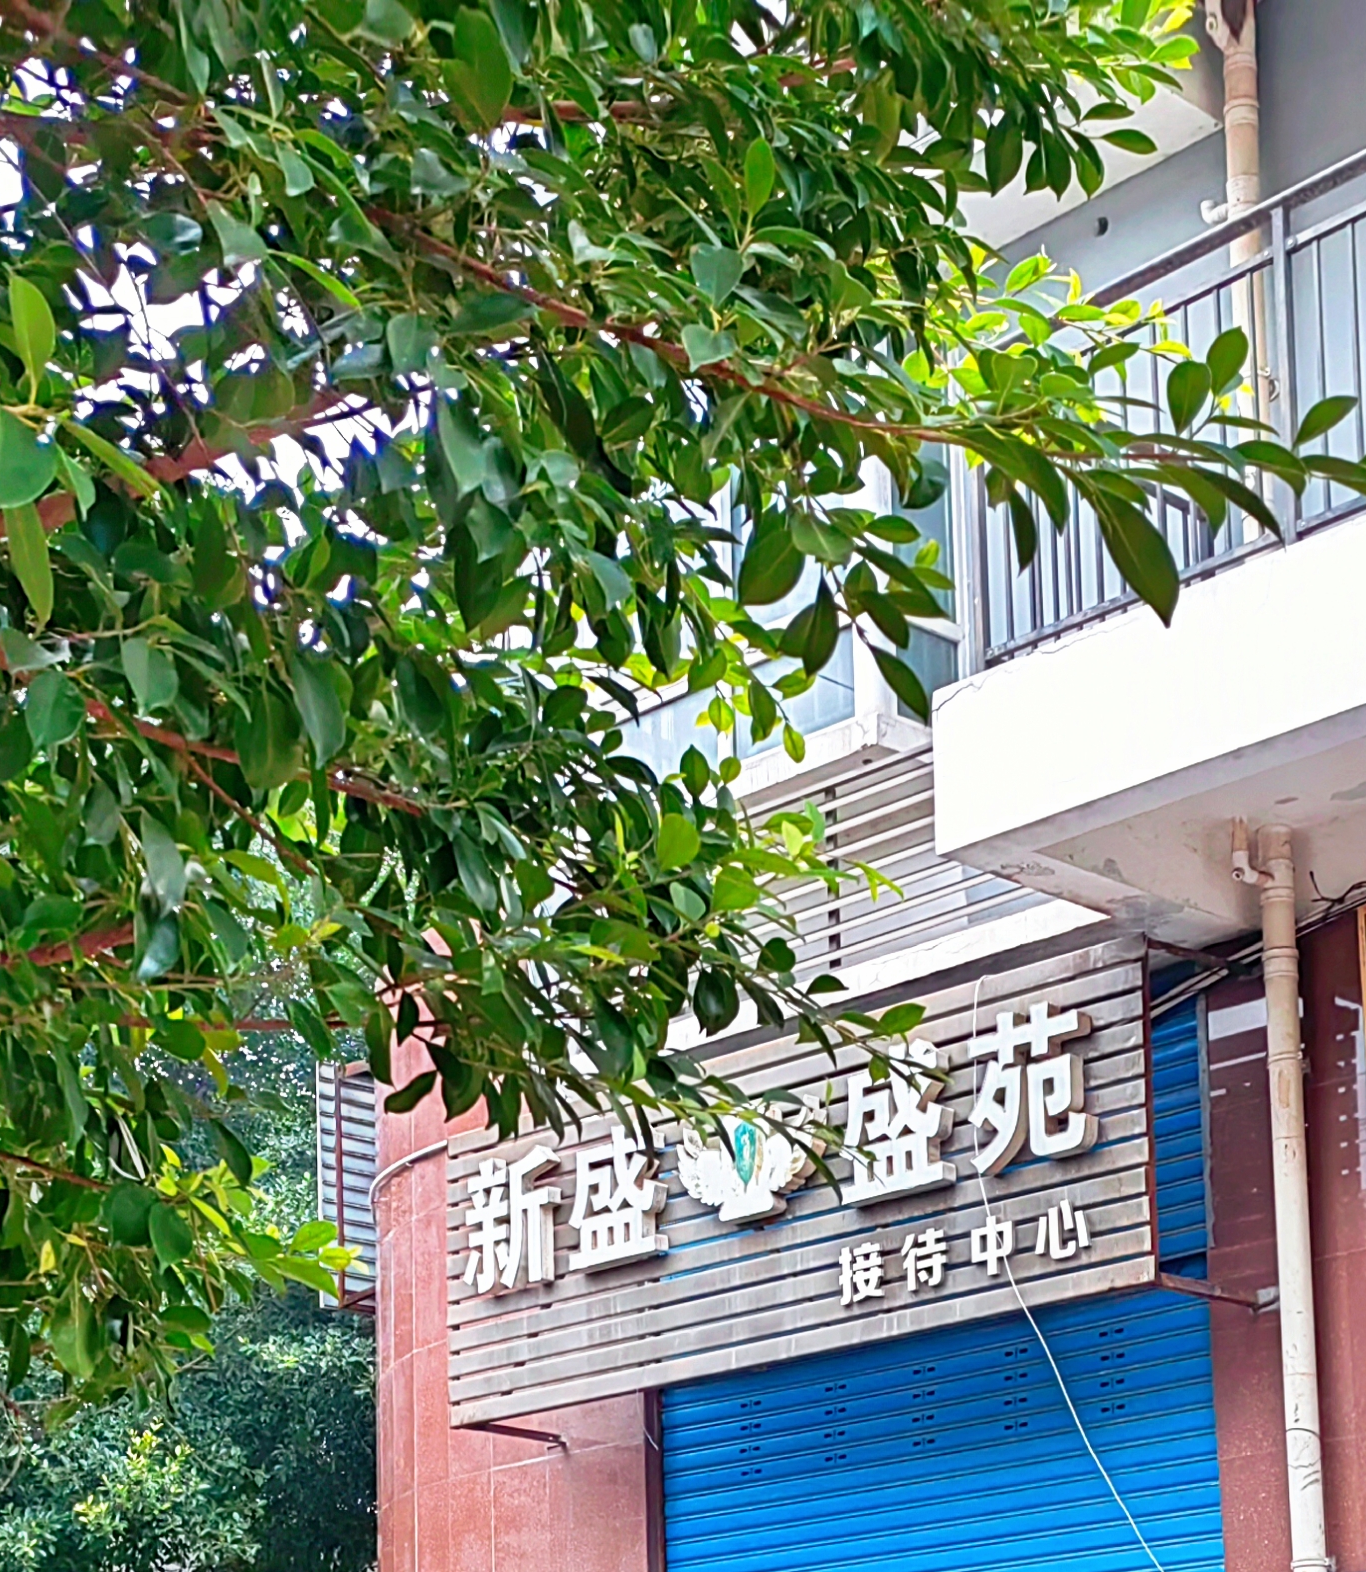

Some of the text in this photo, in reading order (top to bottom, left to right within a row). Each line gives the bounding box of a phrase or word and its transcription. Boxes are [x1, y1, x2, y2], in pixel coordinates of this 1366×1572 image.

[463, 1001, 1099, 1294] 新盛 盛苑
[839, 1199, 1091, 1306] 接待中心
